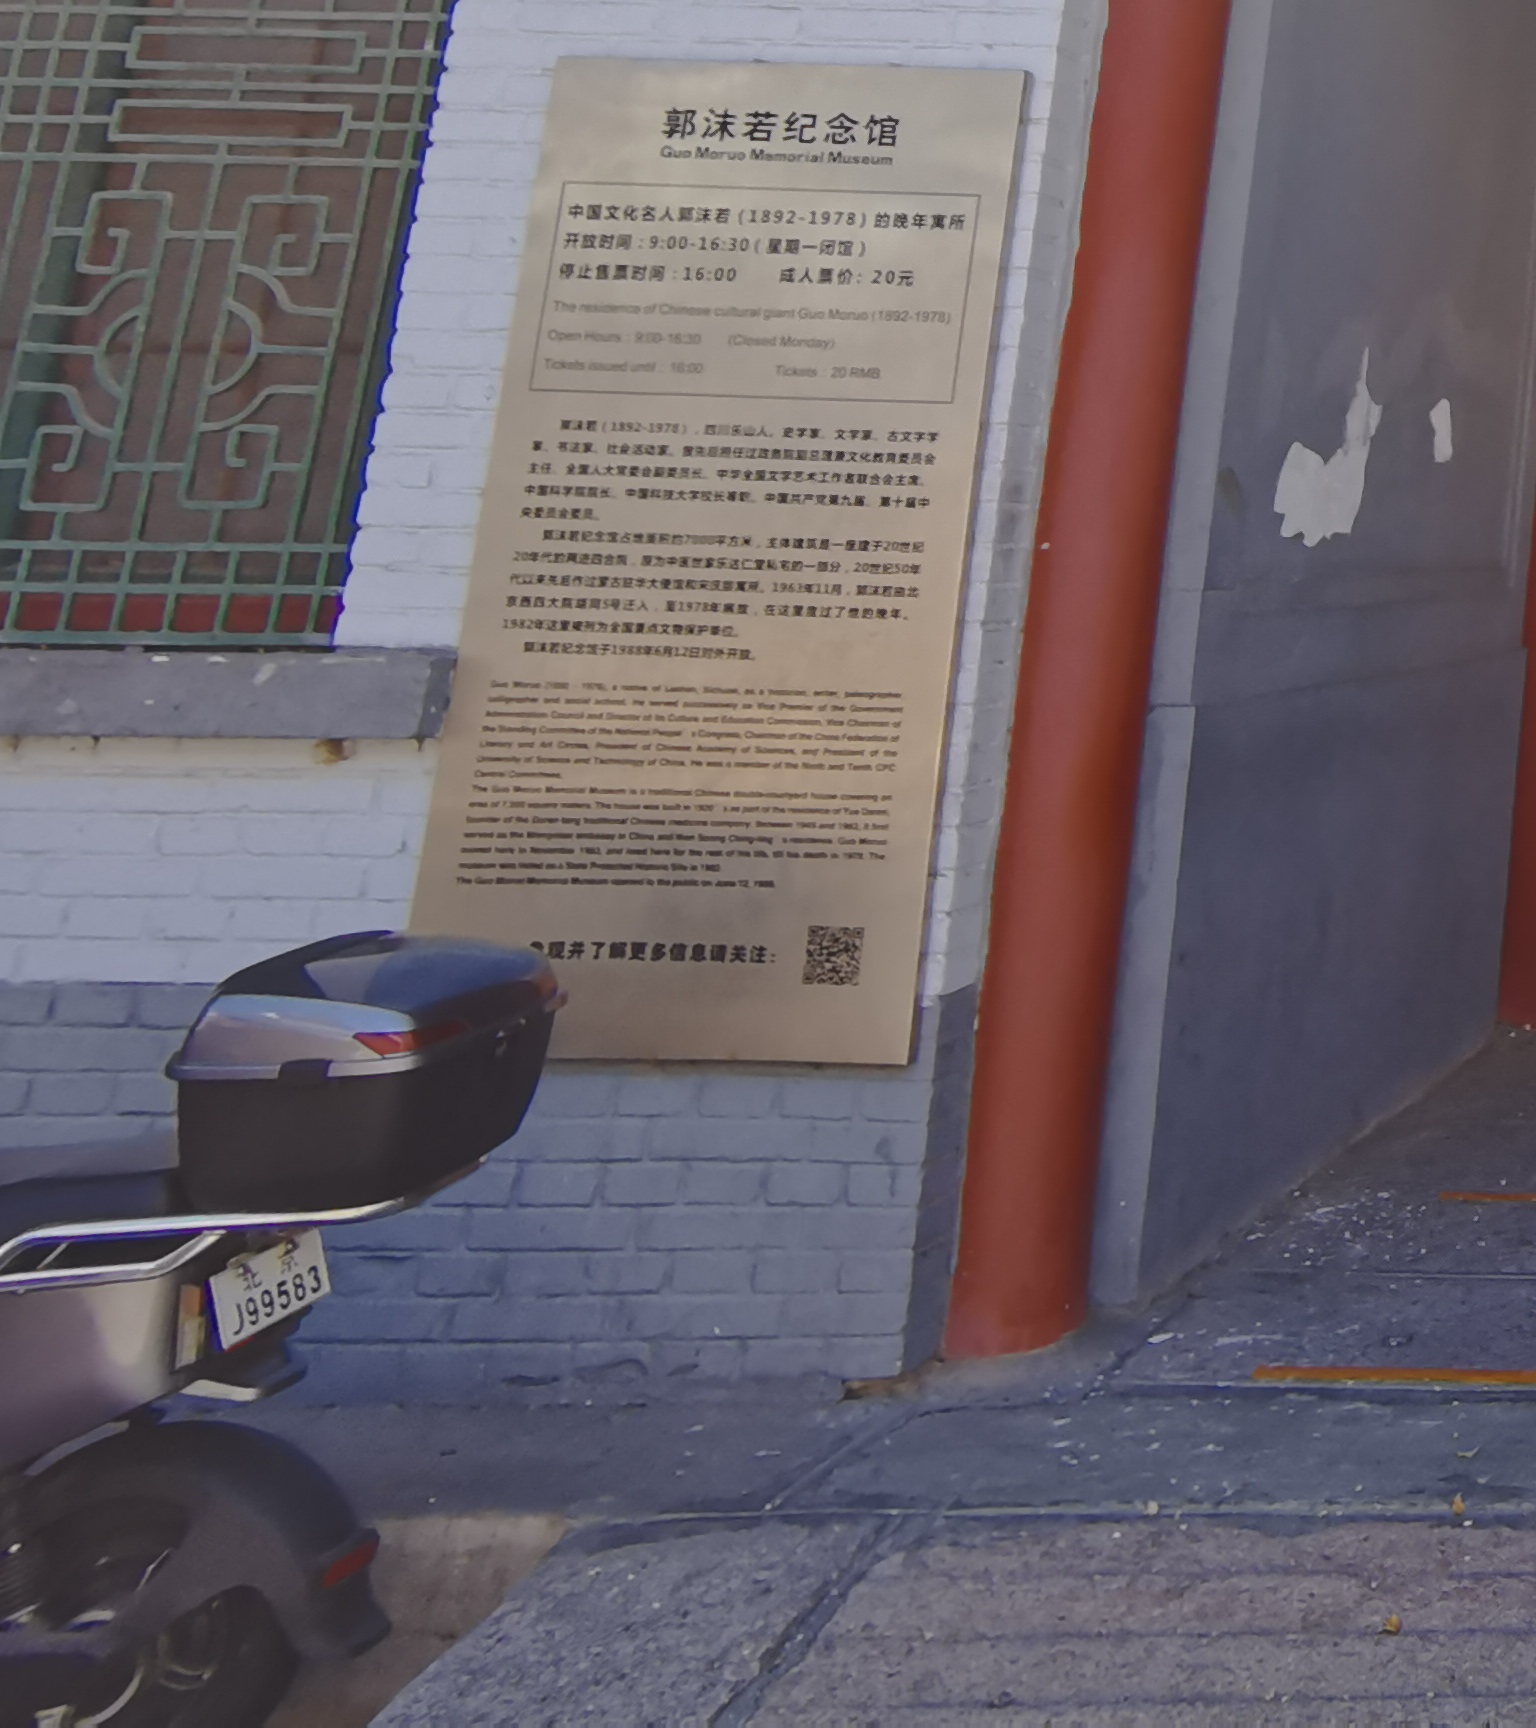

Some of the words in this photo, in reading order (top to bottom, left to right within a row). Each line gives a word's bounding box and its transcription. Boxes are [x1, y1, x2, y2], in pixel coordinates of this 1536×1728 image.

[662, 107, 900, 147] 郭沫若纪念馆
[660, 145, 692, 159] Guo
[695, 146, 746, 161] Moruo
[750, 147, 824, 163] Memorial
[828, 151, 893, 166] Museum
[233, 1265, 321, 1336] J99583
